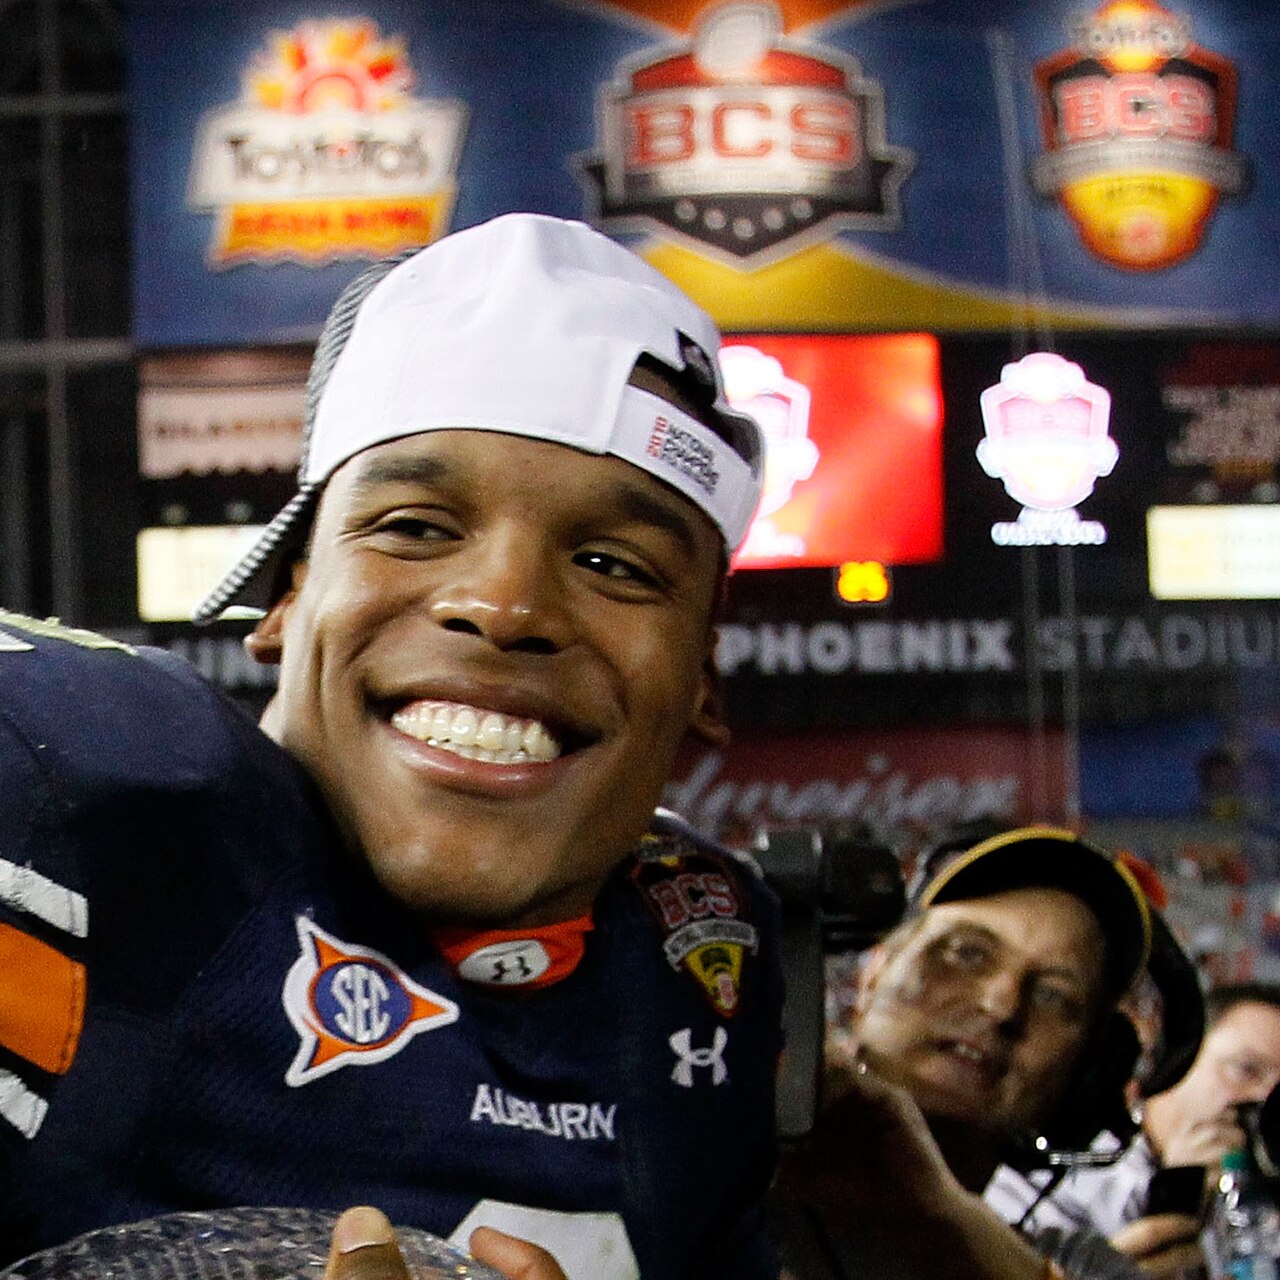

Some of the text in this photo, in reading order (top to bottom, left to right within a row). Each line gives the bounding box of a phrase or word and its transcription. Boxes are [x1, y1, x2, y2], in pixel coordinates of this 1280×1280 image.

[631, 101, 857, 164] BCS
[1061, 82, 1216, 144] BCS
[714, 620, 1014, 674] PHOENIX
[330, 963, 390, 1044] SEC
[469, 1083, 618, 1140] AUBURN
